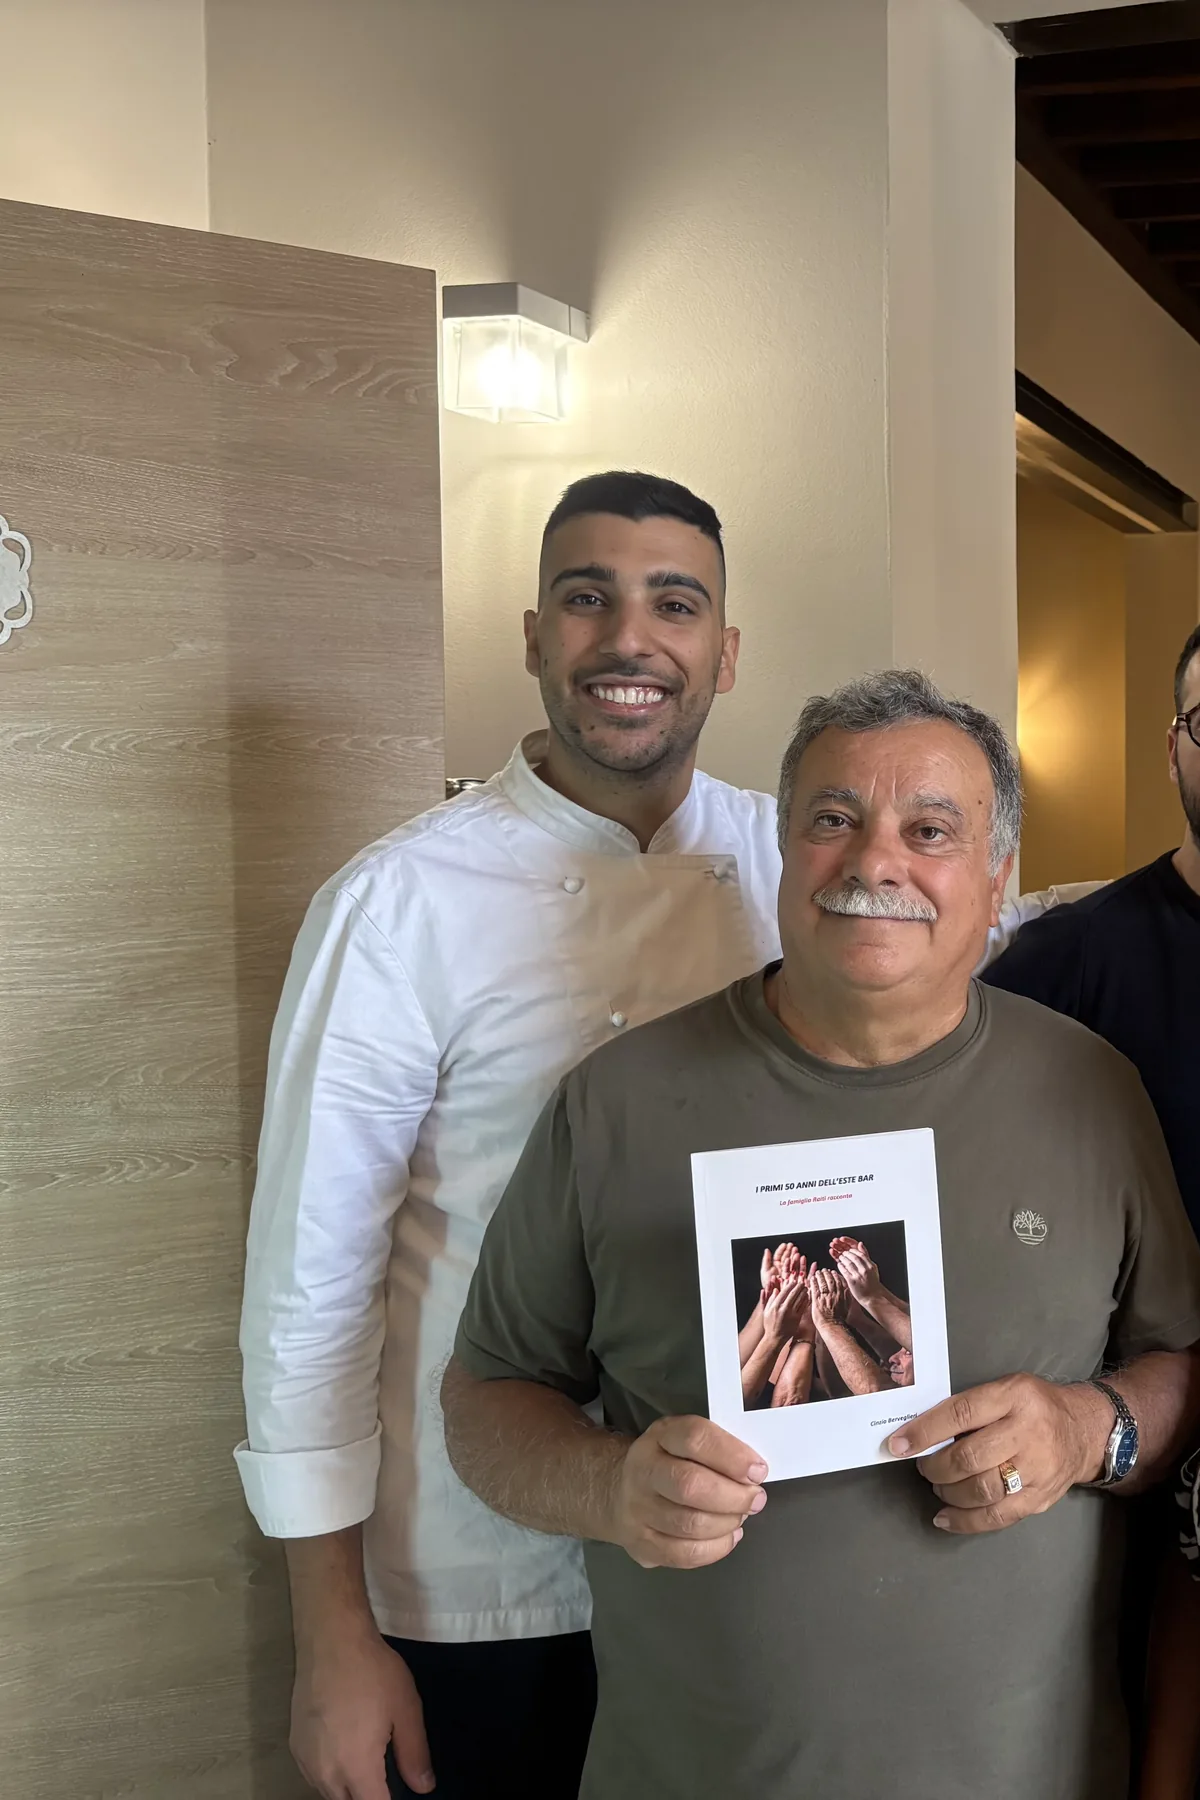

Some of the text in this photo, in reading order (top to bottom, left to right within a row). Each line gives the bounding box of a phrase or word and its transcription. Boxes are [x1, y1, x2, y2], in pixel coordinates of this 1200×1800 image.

[760, 1184, 784, 1193] PRIMI
[784, 1182, 795, 1191] 50
[796, 1180, 817, 1190] ANNI
[818, 1176, 856, 1187] DELL'ESTE
[858, 1174, 874, 1182] BAR
[787, 1197, 812, 1206] famiglia
[827, 1193, 853, 1201] racconta
